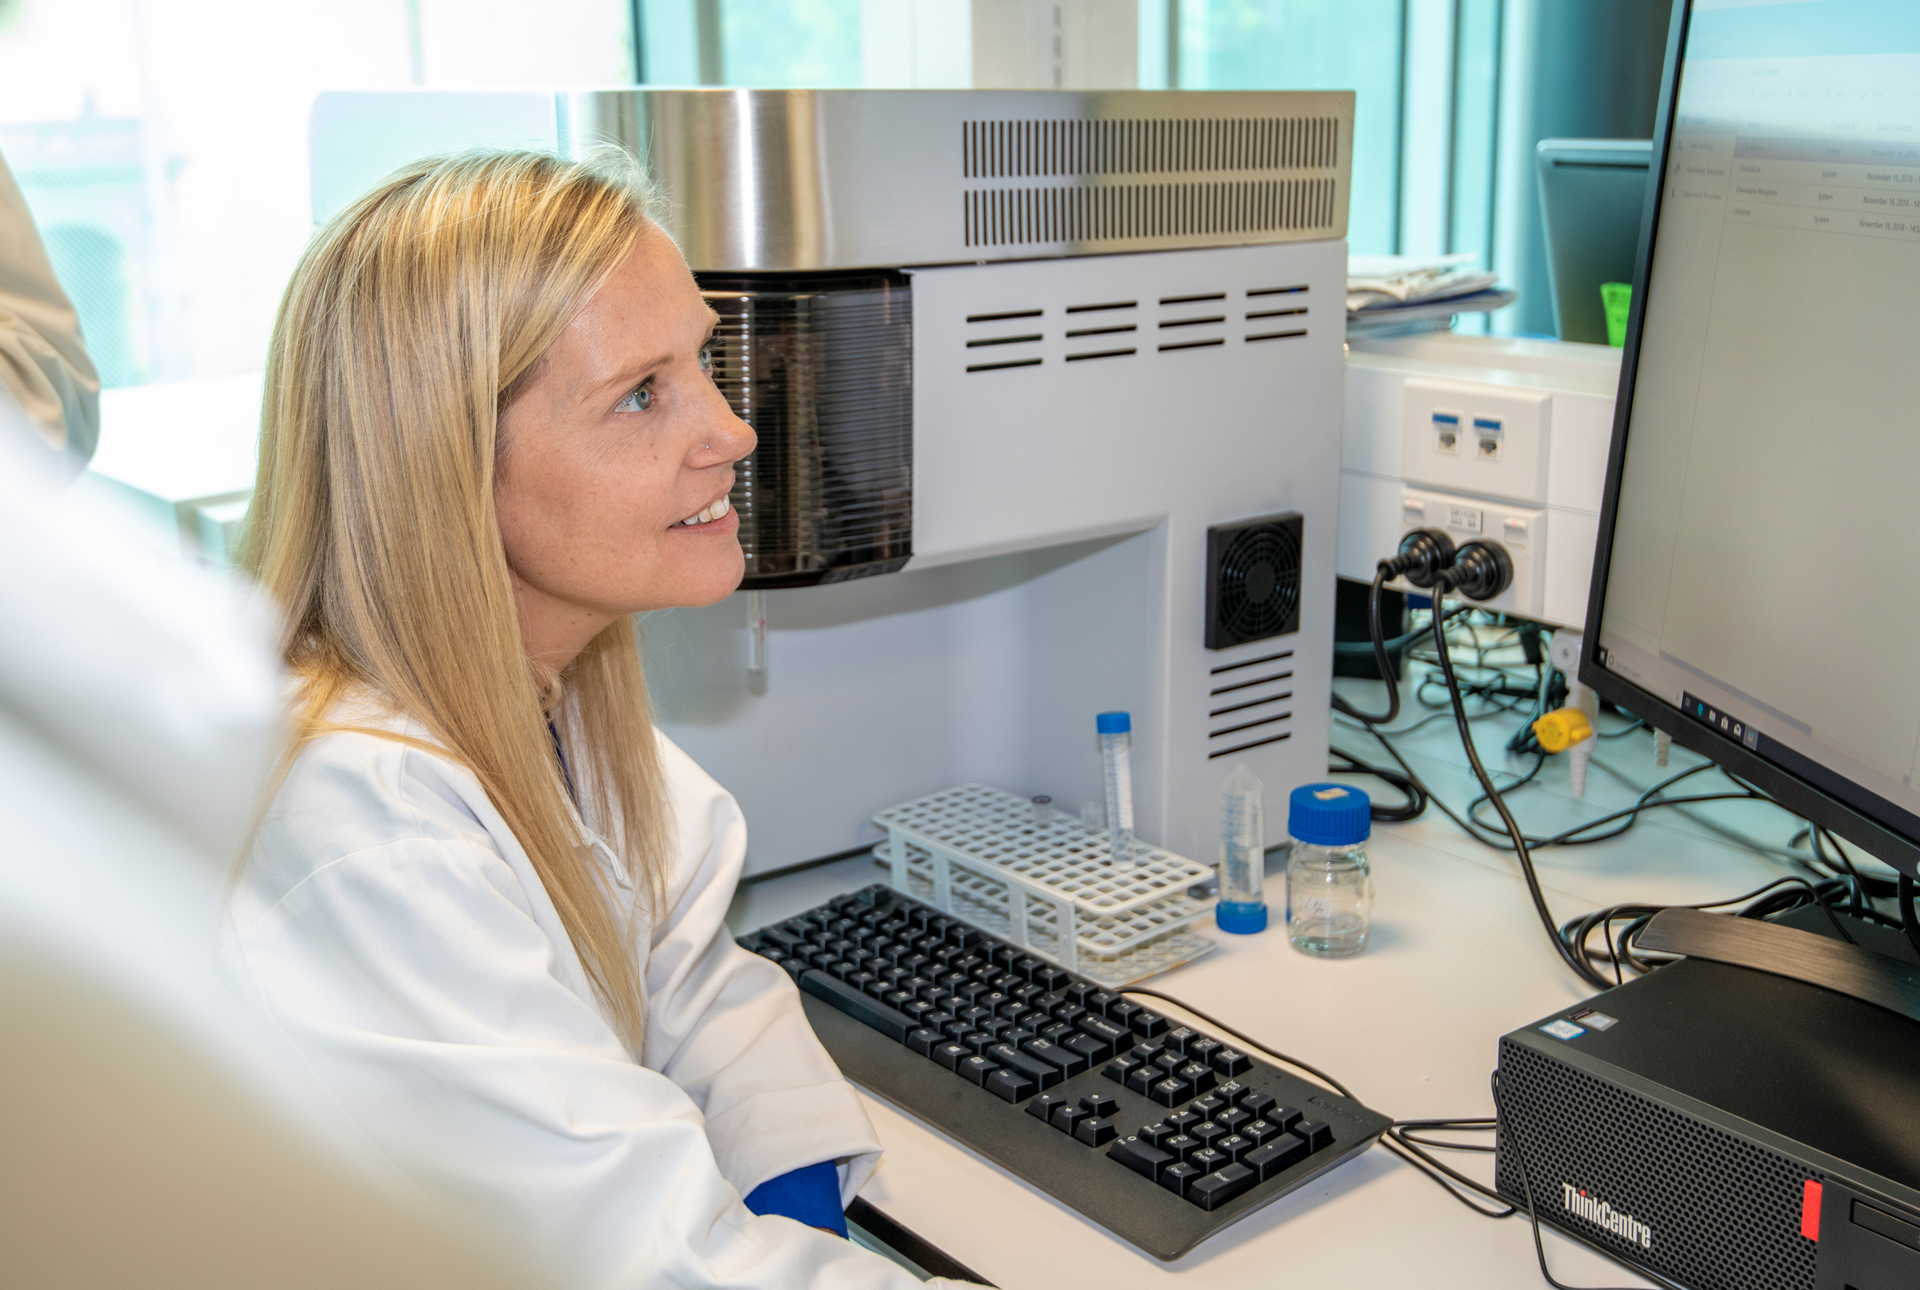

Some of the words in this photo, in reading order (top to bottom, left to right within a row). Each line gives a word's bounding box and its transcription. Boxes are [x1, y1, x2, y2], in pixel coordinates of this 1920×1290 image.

[1876, 122, 1889, 132] Date
[1890, 123, 1913, 133] Created
[1866, 172, 1892, 182] November
[1900, 174, 1914, 184] 2018
[1863, 195, 1888, 206] November
[1896, 198, 1910, 208] 2018
[1859, 219, 1884, 230] November
[1892, 222, 1905, 232] 2018
[1562, 1181, 1653, 1250] ThinkCentre
